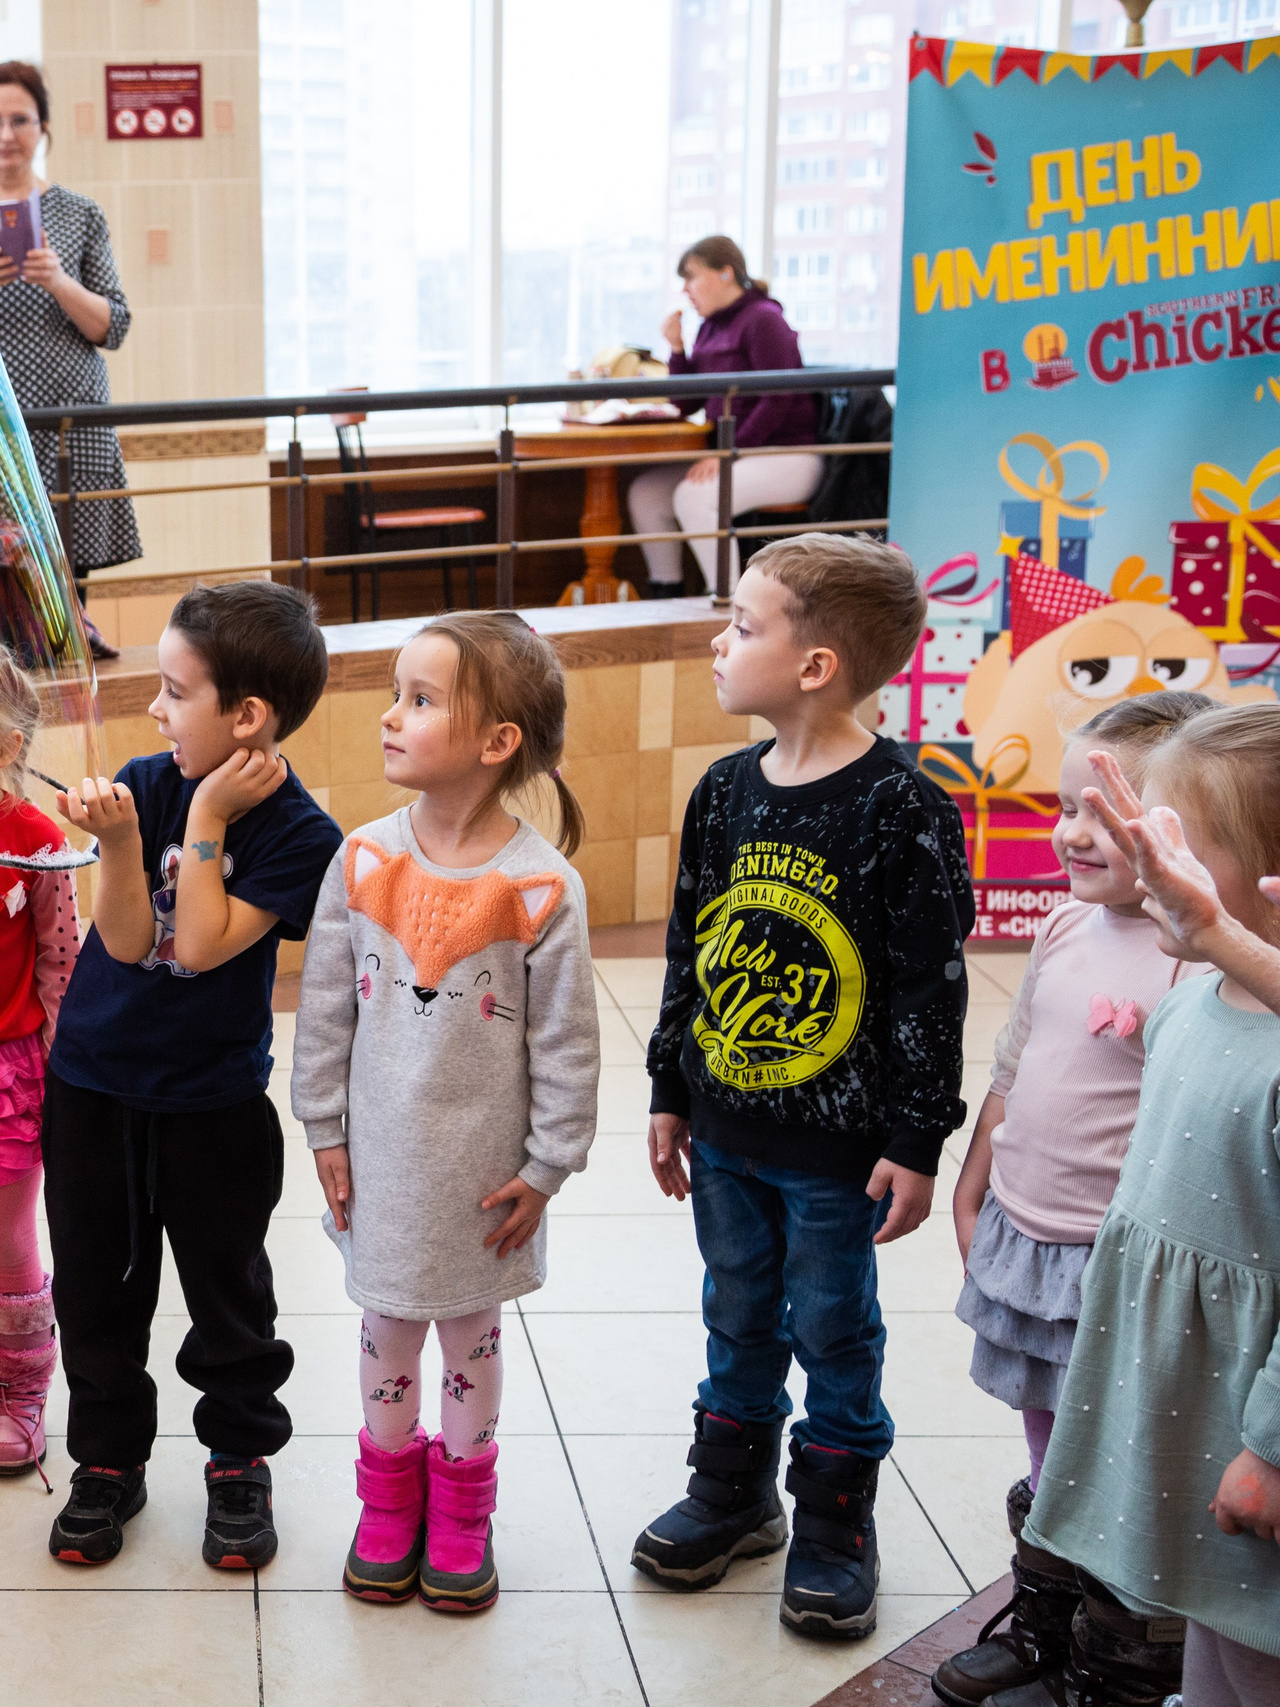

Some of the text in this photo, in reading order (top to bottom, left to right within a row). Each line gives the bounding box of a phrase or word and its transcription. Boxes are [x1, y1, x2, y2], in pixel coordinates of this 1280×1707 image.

[1026, 131, 1202, 230] ДЕНЬ
[1146, 289, 1238, 317] SOUTHERN
[730, 854, 839, 901] DENIM&CO.
[738, 841, 827, 868] THE BEST IN TOWN
[779, 892, 827, 929] GOODS
[708, 918, 777, 973] New
[781, 963, 831, 1010] 37
[710, 971, 835, 1070] York
